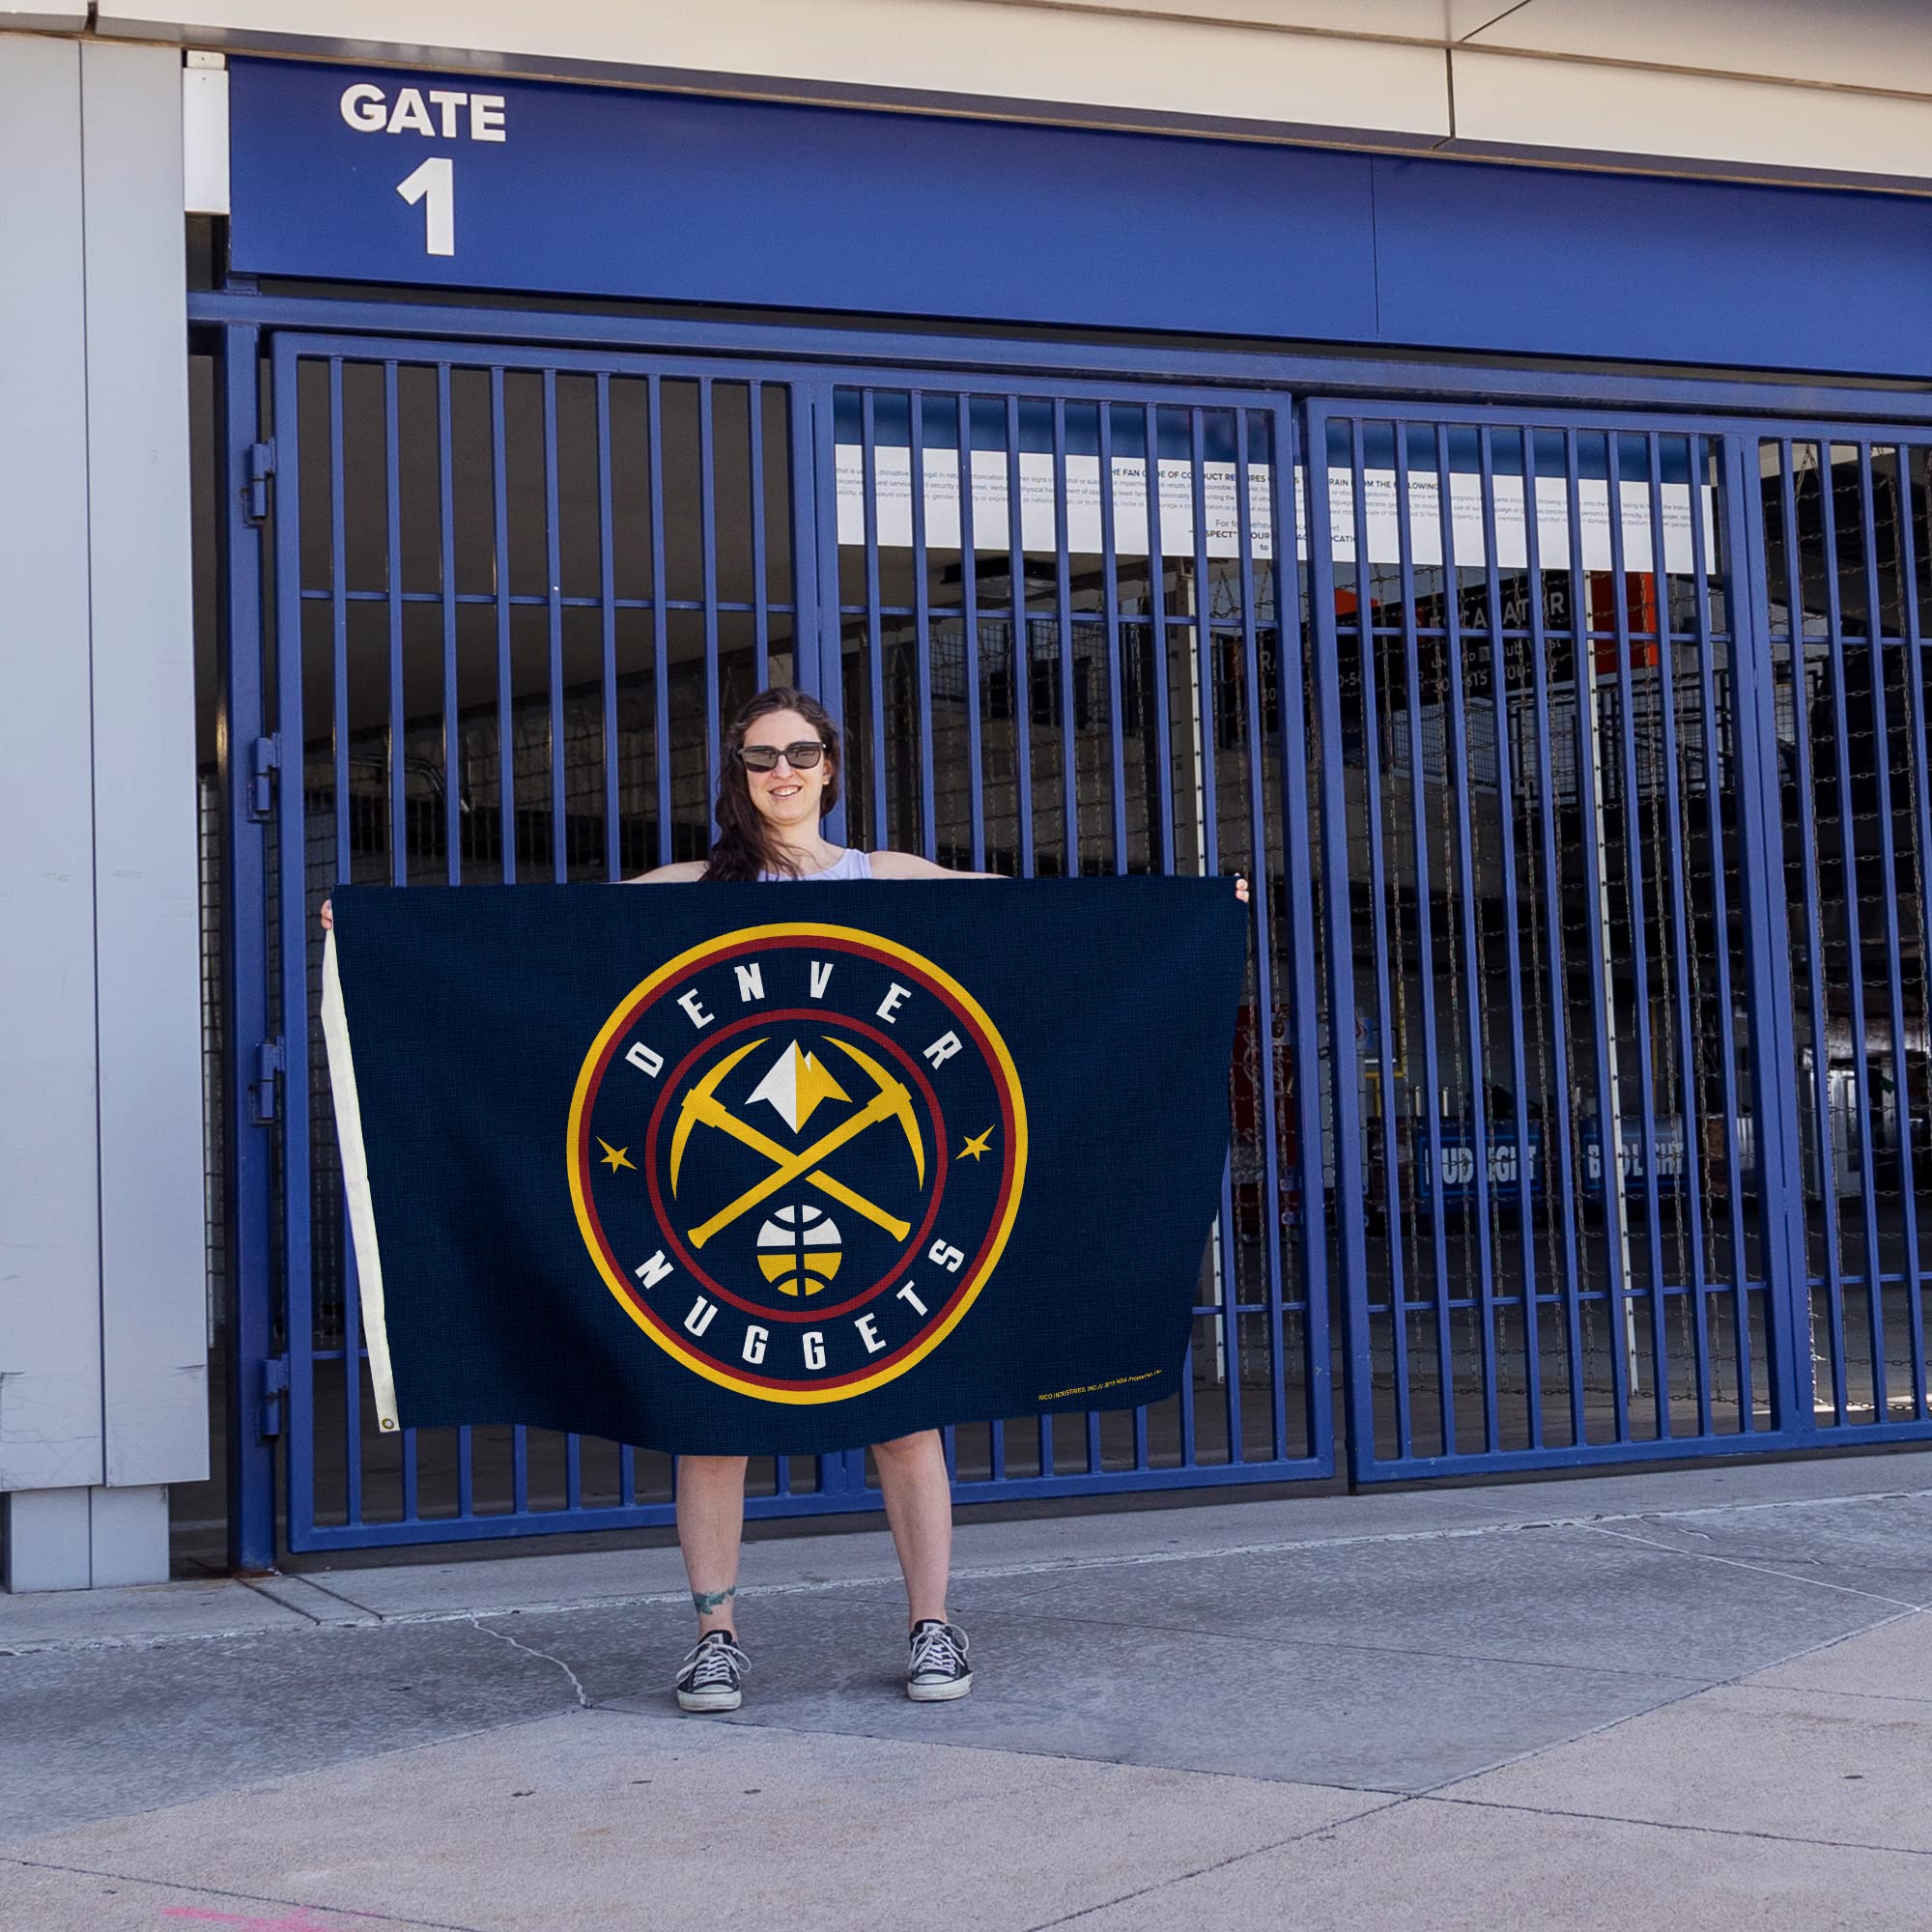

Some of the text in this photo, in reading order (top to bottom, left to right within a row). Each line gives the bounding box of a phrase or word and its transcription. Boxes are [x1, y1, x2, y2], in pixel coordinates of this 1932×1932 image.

[340, 83, 506, 142] GATE
[396, 156, 455, 256] 1
[1215, 519, 1232, 527] For
[625, 961, 963, 1078] DENVER
[1425, 1148, 1474, 1184] UD
[635, 1238, 964, 1371] NUGGETS
